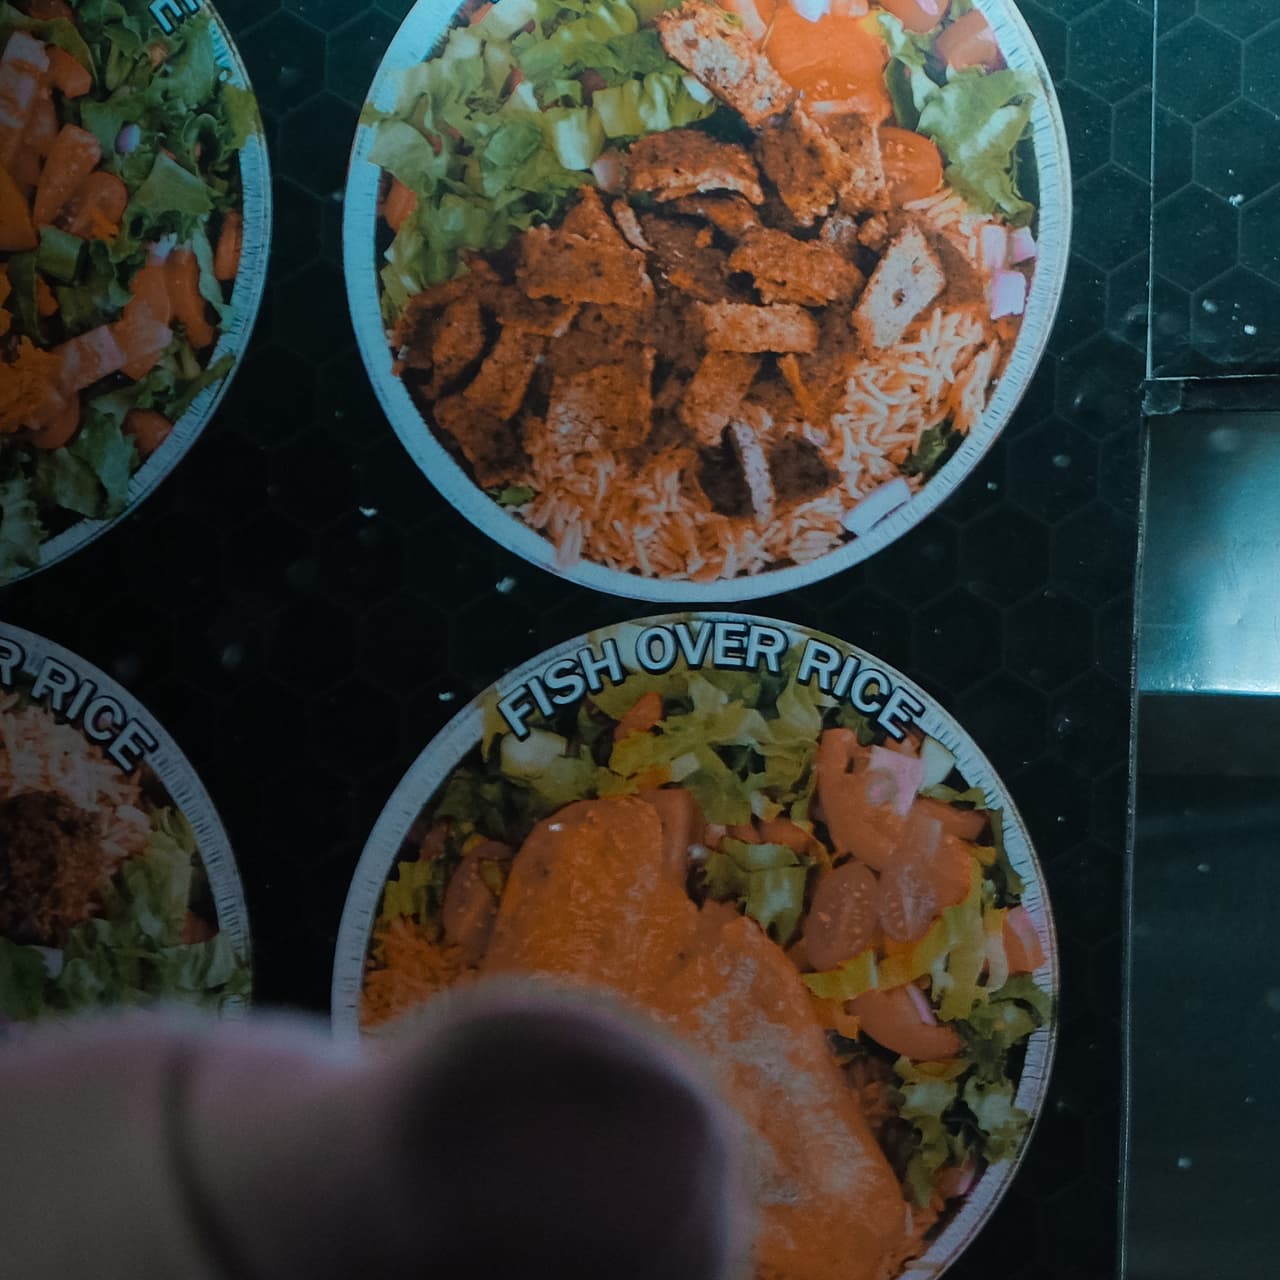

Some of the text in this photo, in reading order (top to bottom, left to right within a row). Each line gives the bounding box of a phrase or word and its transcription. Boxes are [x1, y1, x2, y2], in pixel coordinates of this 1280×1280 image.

[30, 656, 160, 774] RICE
[497, 621, 926, 742] FISH OVER RICE
